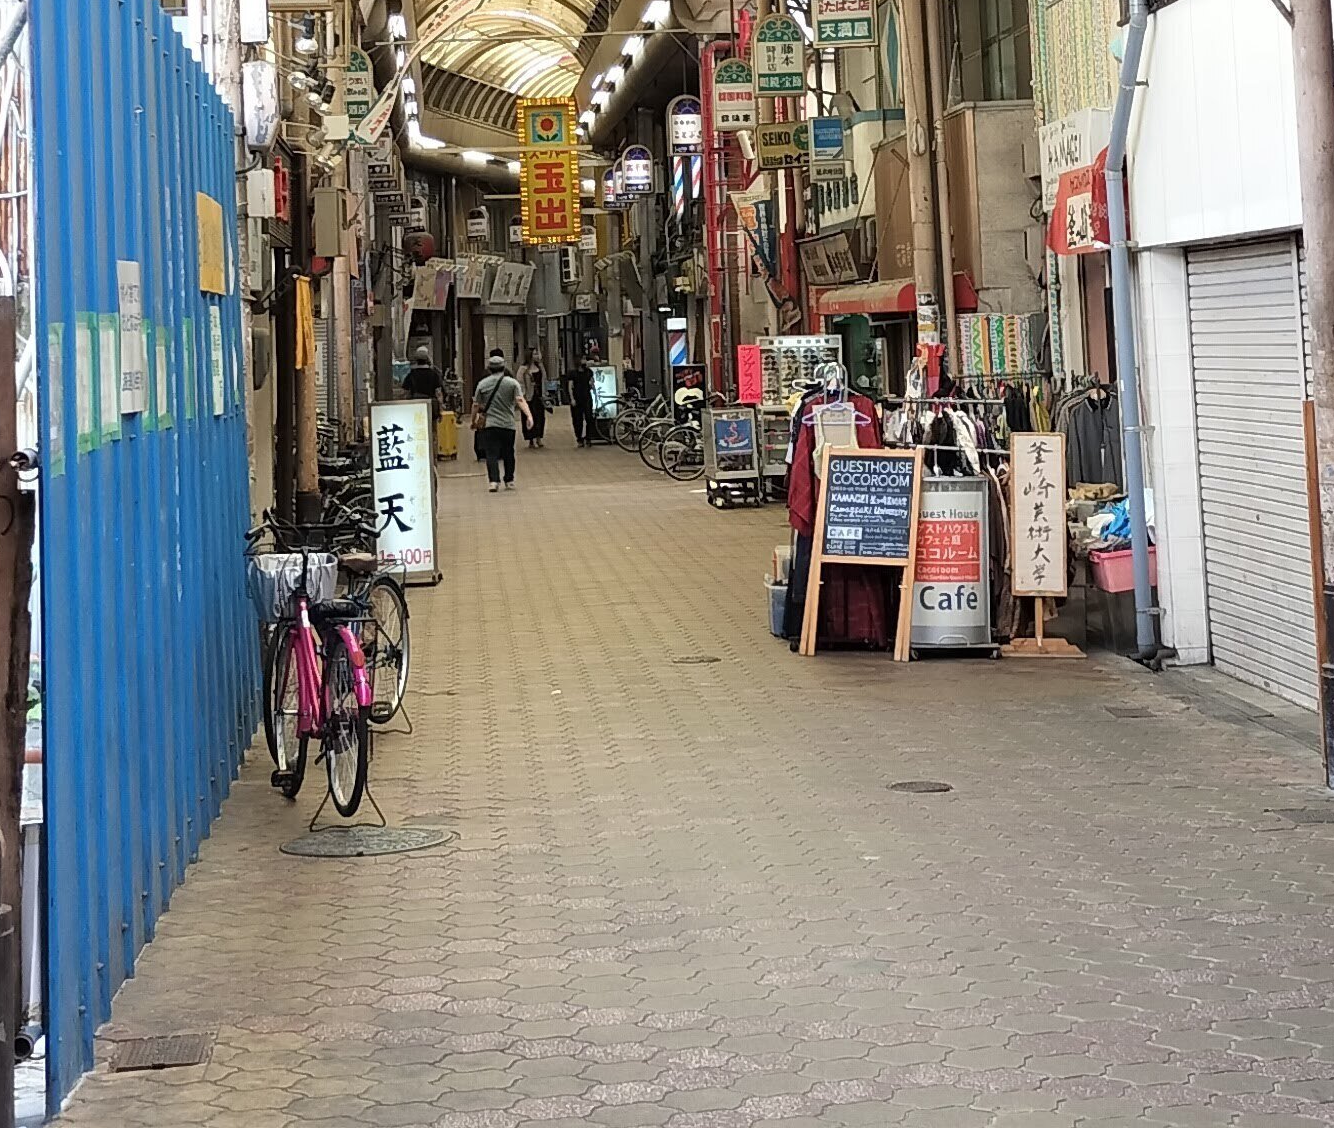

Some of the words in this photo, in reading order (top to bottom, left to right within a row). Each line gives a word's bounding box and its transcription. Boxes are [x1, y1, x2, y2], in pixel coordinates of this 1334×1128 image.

[761, 132, 791, 147] SEIKO
[533, 162, 568, 229] 玉出
[830, 460, 913, 474] GUESTHOUSE
[375, 423, 414, 533] 藍天
[832, 473, 910, 487] COCOROOM
[919, 510, 947, 518] uest
[949, 508, 979, 518] House
[917, 546, 978, 560] ココルーム
[919, 584, 979, 610] Café
